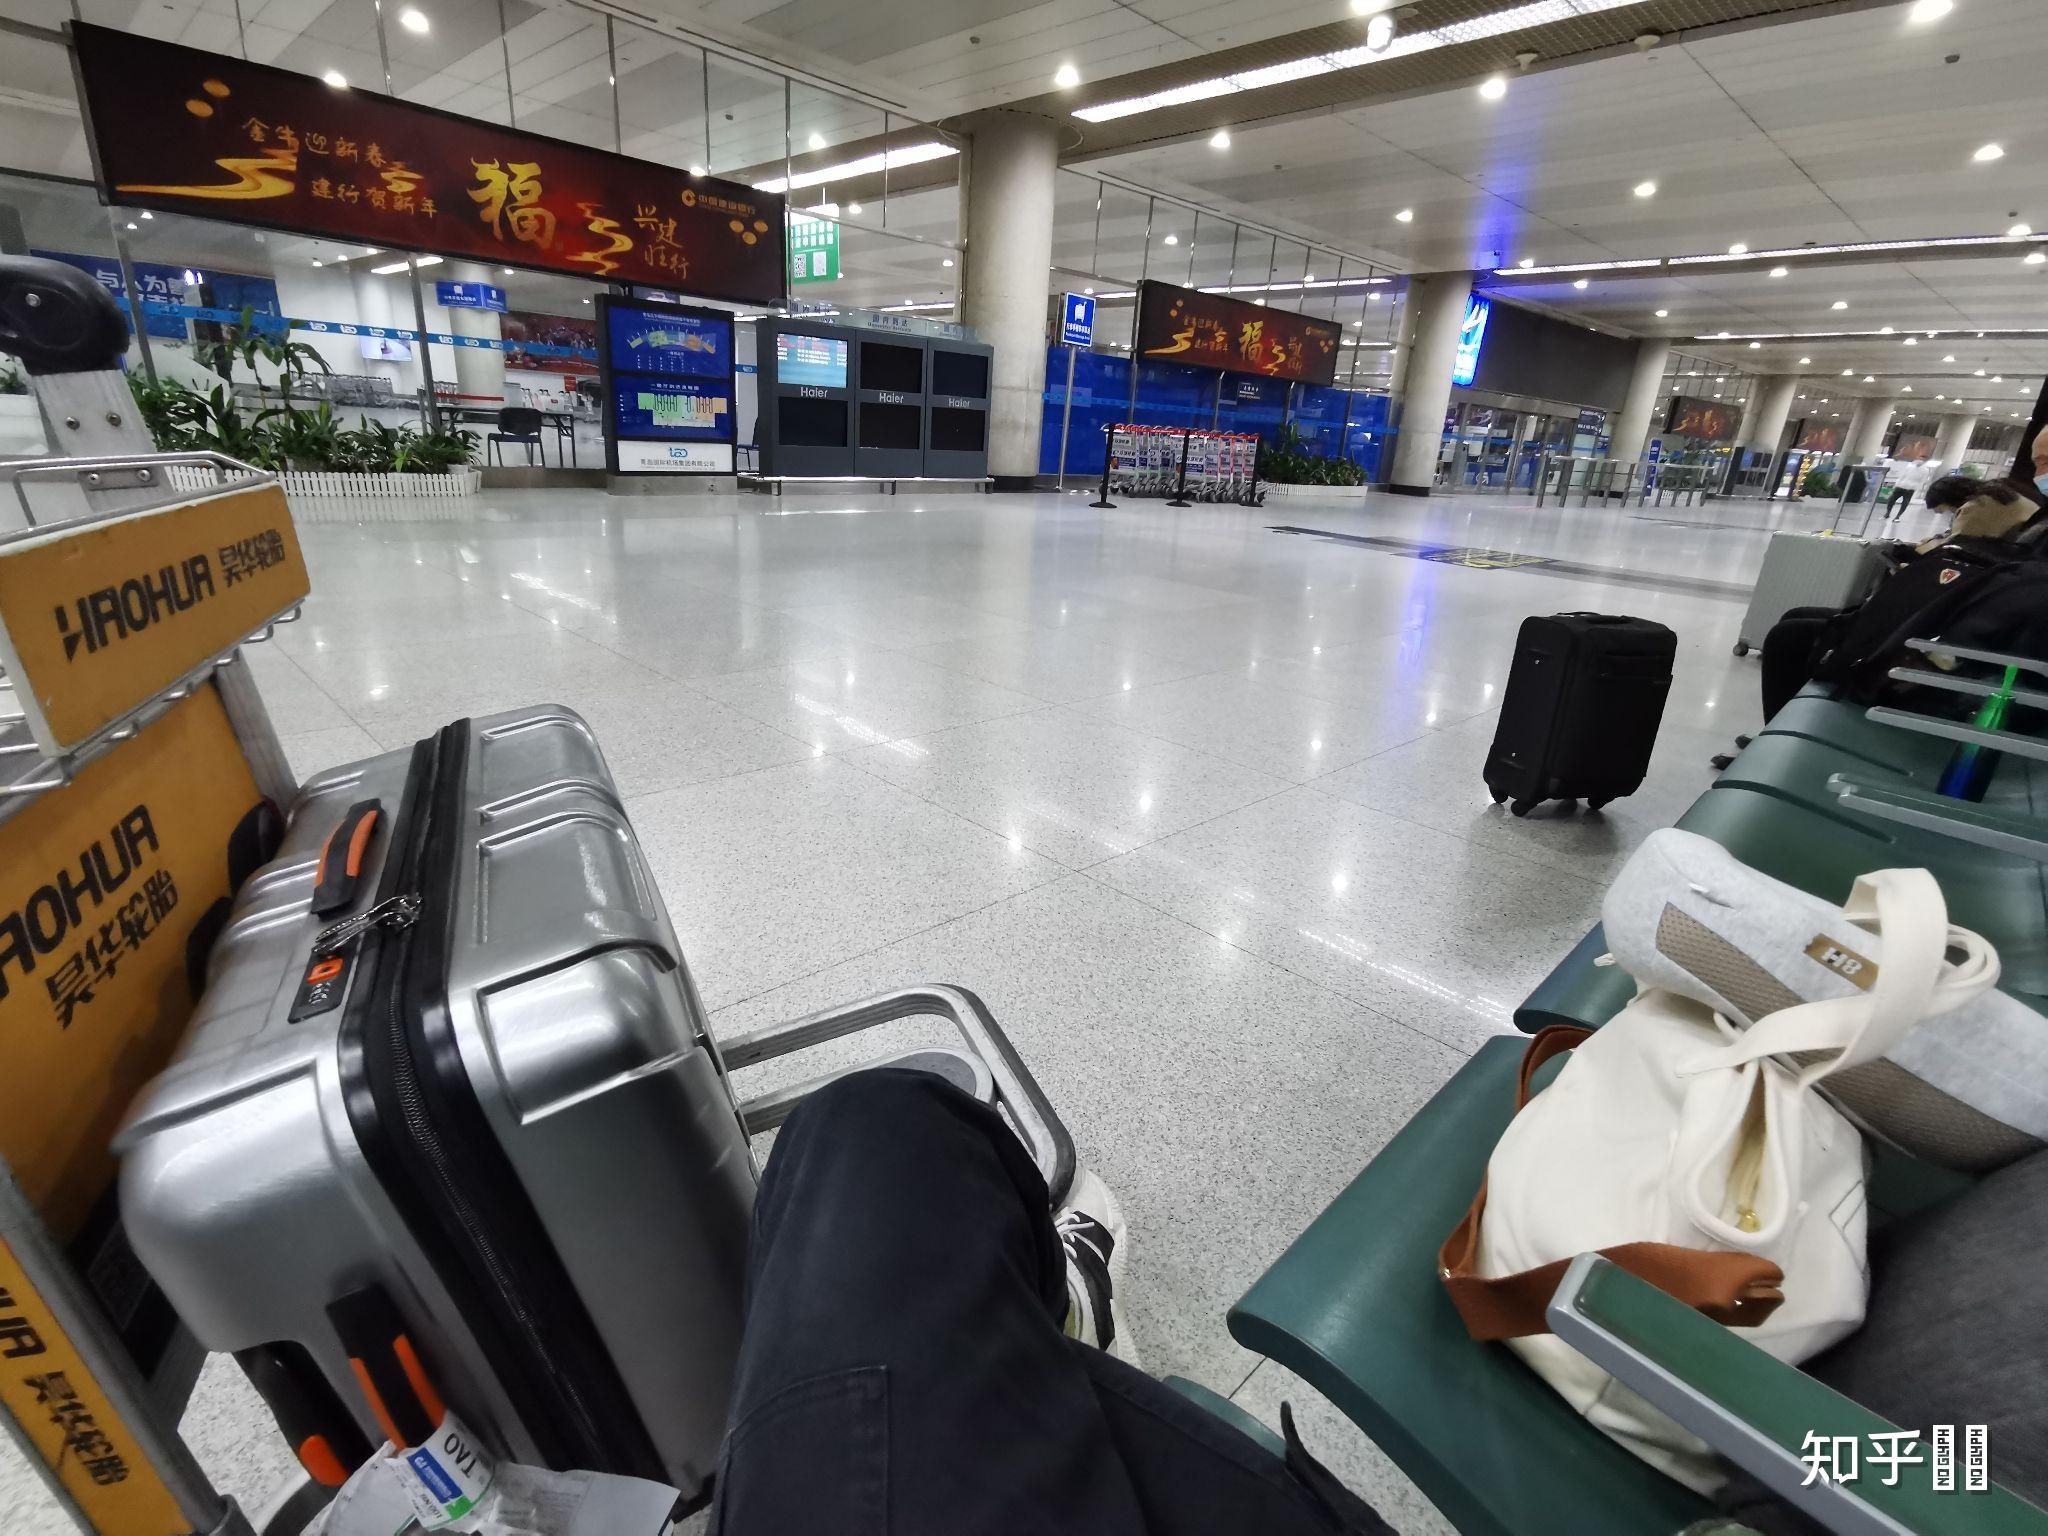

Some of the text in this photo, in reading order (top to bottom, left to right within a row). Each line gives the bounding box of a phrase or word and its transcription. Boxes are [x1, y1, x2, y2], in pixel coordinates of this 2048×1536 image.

[242, 116, 387, 168] 金牛迎新春
[311, 176, 438, 219] 建行贺新年
[465, 156, 558, 250] 福
[799, 386, 829, 399] Haier
[878, 392, 905, 405] Haier
[948, 397, 971, 409] Haier
[54, 553, 216, 664] HAOHUA
[45, 868, 179, 1031] 昊华轮胎
